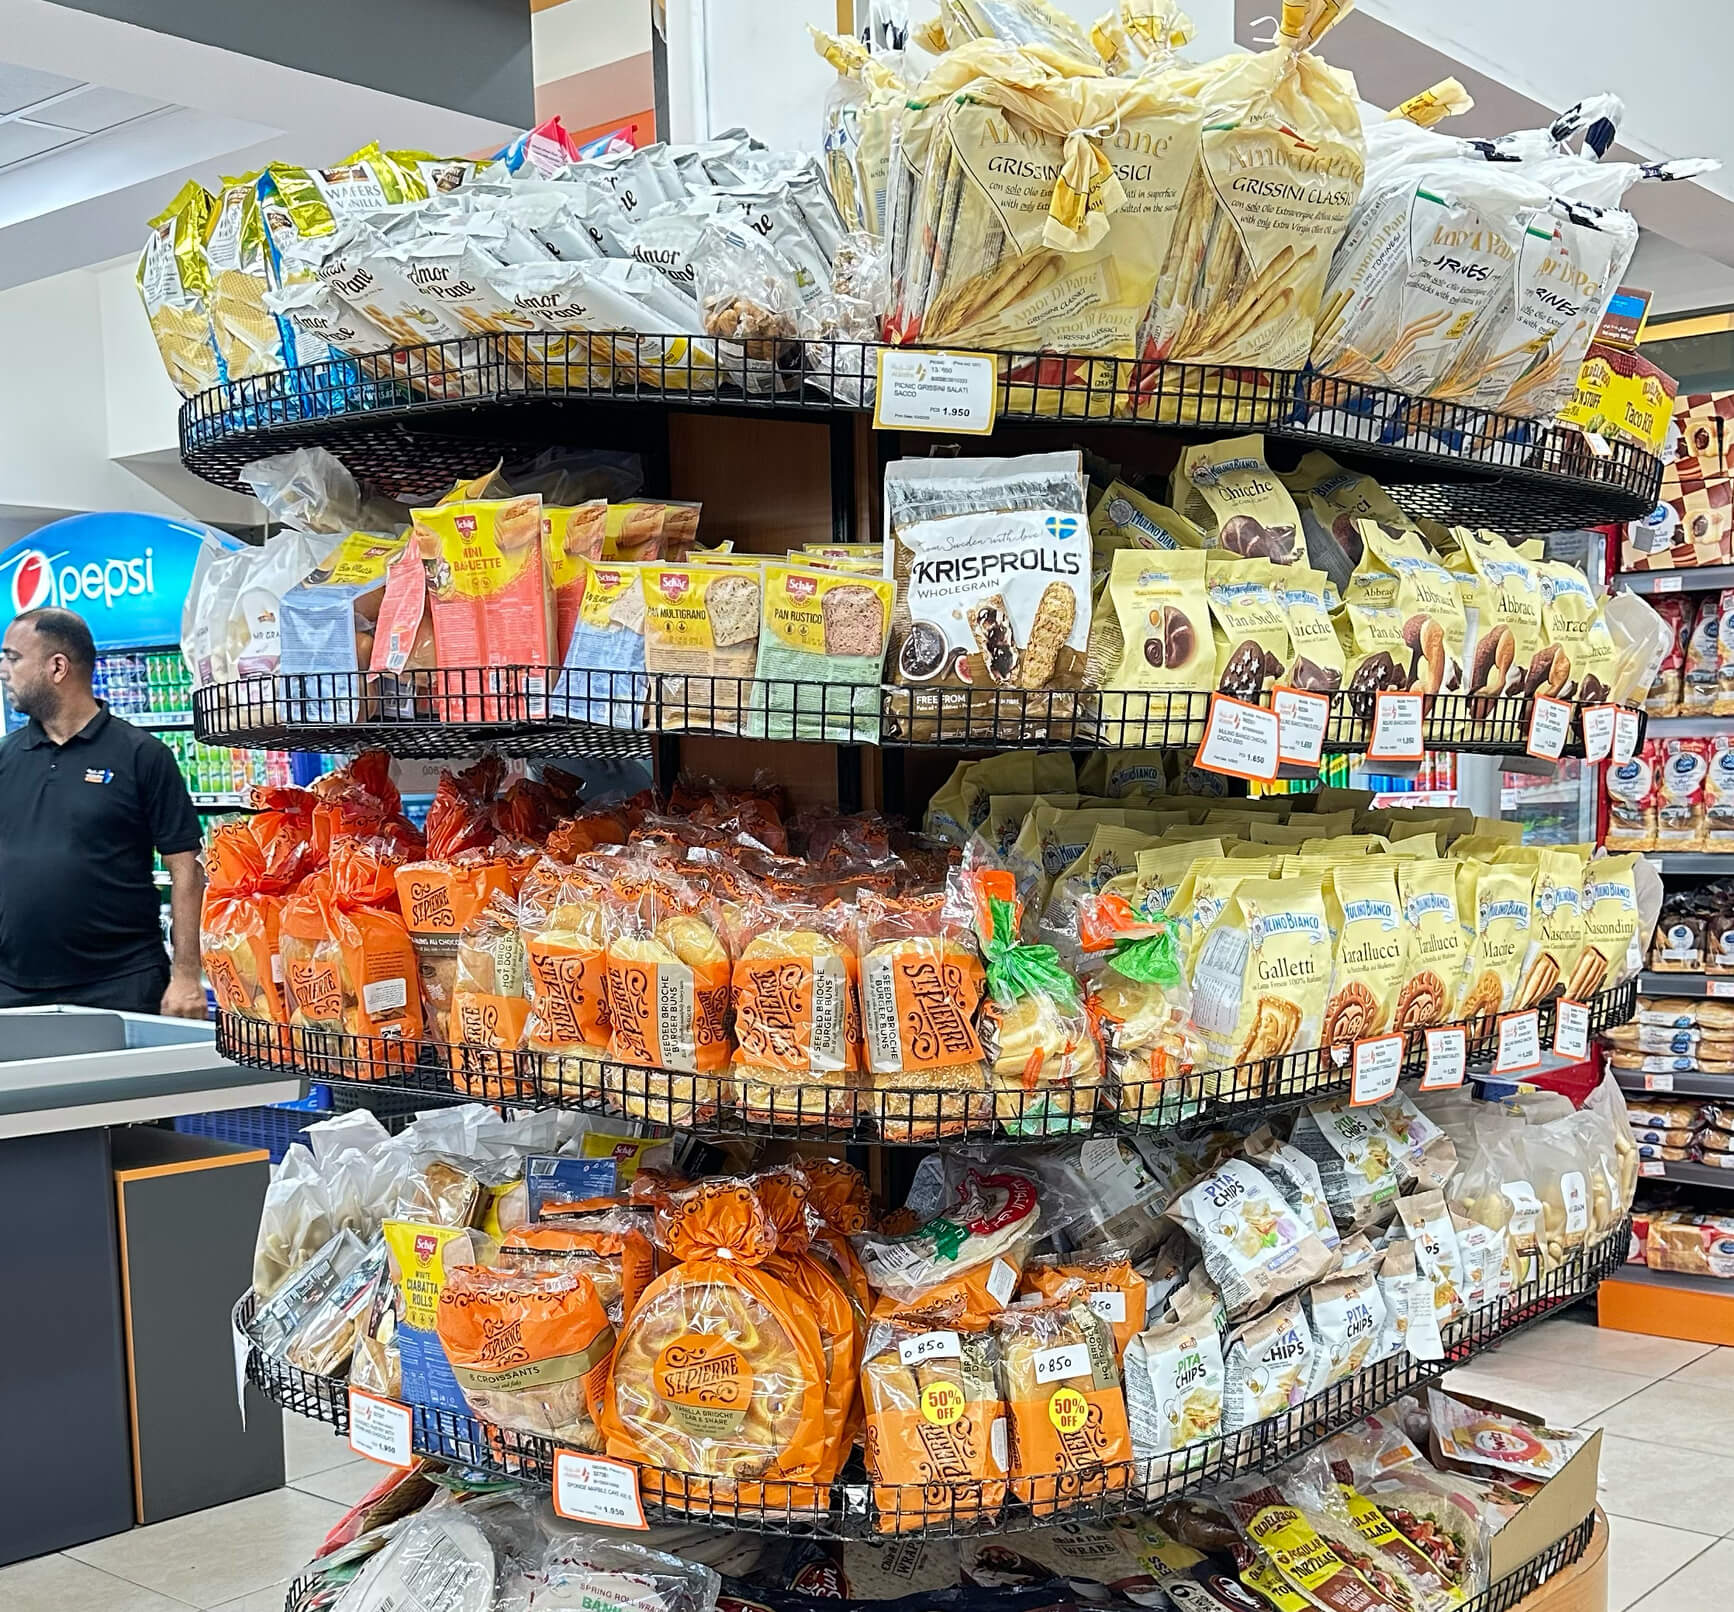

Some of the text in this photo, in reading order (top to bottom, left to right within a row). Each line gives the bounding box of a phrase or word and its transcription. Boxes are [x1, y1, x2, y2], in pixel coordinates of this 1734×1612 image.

[1233, 177, 1305, 201] GRISSINI
[632, 245, 680, 265] Amor
[332, 266, 376, 296] Pane
[408, 262, 450, 286] Amor
[435, 280, 476, 298] Pane
[514, 290, 562, 309] Amor
[542, 302, 586, 320] Pane
[943, 408, 970, 416] 1.950
[1625, 402, 1642, 428] Taco
[1218, 479, 1274, 502] Chicche
[1131, 510, 1160, 539] MULINO
[946, 534, 986, 553] Sweden
[912, 548, 1080, 584] KRISPROLLS
[59, 547, 154, 608] pepsi
[918, 578, 1000, 600] WHOLEGRAIN
[660, 608, 706, 620] MULTIGRANO
[774, 608, 823, 624] PAN RUSTICO
[1226, 614, 1248, 628] Pan
[916, 696, 938, 704] FREE
[1610, 882, 1631, 898] BIANCO
[1366, 899, 1392, 917] BIANCO
[1508, 900, 1528, 918] BIANCO
[1286, 912, 1320, 930] BIANCO
[1584, 920, 1634, 934] Nascondini
[1416, 931, 1458, 954] Tarallucci
[502, 945, 512, 988] HOT DOG
[1258, 954, 1314, 981] Galletti
[661, 976, 670, 1021] BRIOCHE
[816, 969, 825, 1013] BRIOCHE
[669, 986, 680, 1054] BURGER BUNS
[876, 980, 889, 1050] BURGER BUNS
[884, 974, 894, 1012] SEEDED
[889, 1015, 899, 1060] BRIOCHE
[920, 988, 973, 1054] PIERRE
[661, 1022, 671, 1057] SEEDED
[1204, 1174, 1234, 1198] PITA
[1213, 1181, 1245, 1208] CHIPS
[406, 1278, 440, 1294] CIABATTA
[412, 1292, 434, 1308] ROLLS
[1346, 1304, 1370, 1324] PITA
[1346, 1314, 1374, 1338] CHIPS
[918, 1340, 944, 1354] 850
[1262, 1341, 1305, 1363] CHIPS
[1048, 1356, 1072, 1372] 850
[1100, 1360, 1110, 1380] HOT
[1177, 1352, 1201, 1372] PITA
[476, 1366, 541, 1384] CROISSANTS
[683, 1356, 739, 1396] PIERRE
[1175, 1363, 1206, 1390] CHIPS
[928, 1390, 962, 1407] 50%
[1054, 1398, 1085, 1414] 50%
[674, 1405, 734, 1420] VANILLA BRIOCHE
[680, 1412, 728, 1426] TEAR SHARE
[936, 1408, 954, 1420] OFF
[1060, 1415, 1078, 1427] OFF
[1063, 1543, 1115, 1556] WRAPS
[580, 1582, 612, 1599] SPRING
[1330, 1581, 1363, 1606] WHOLE
